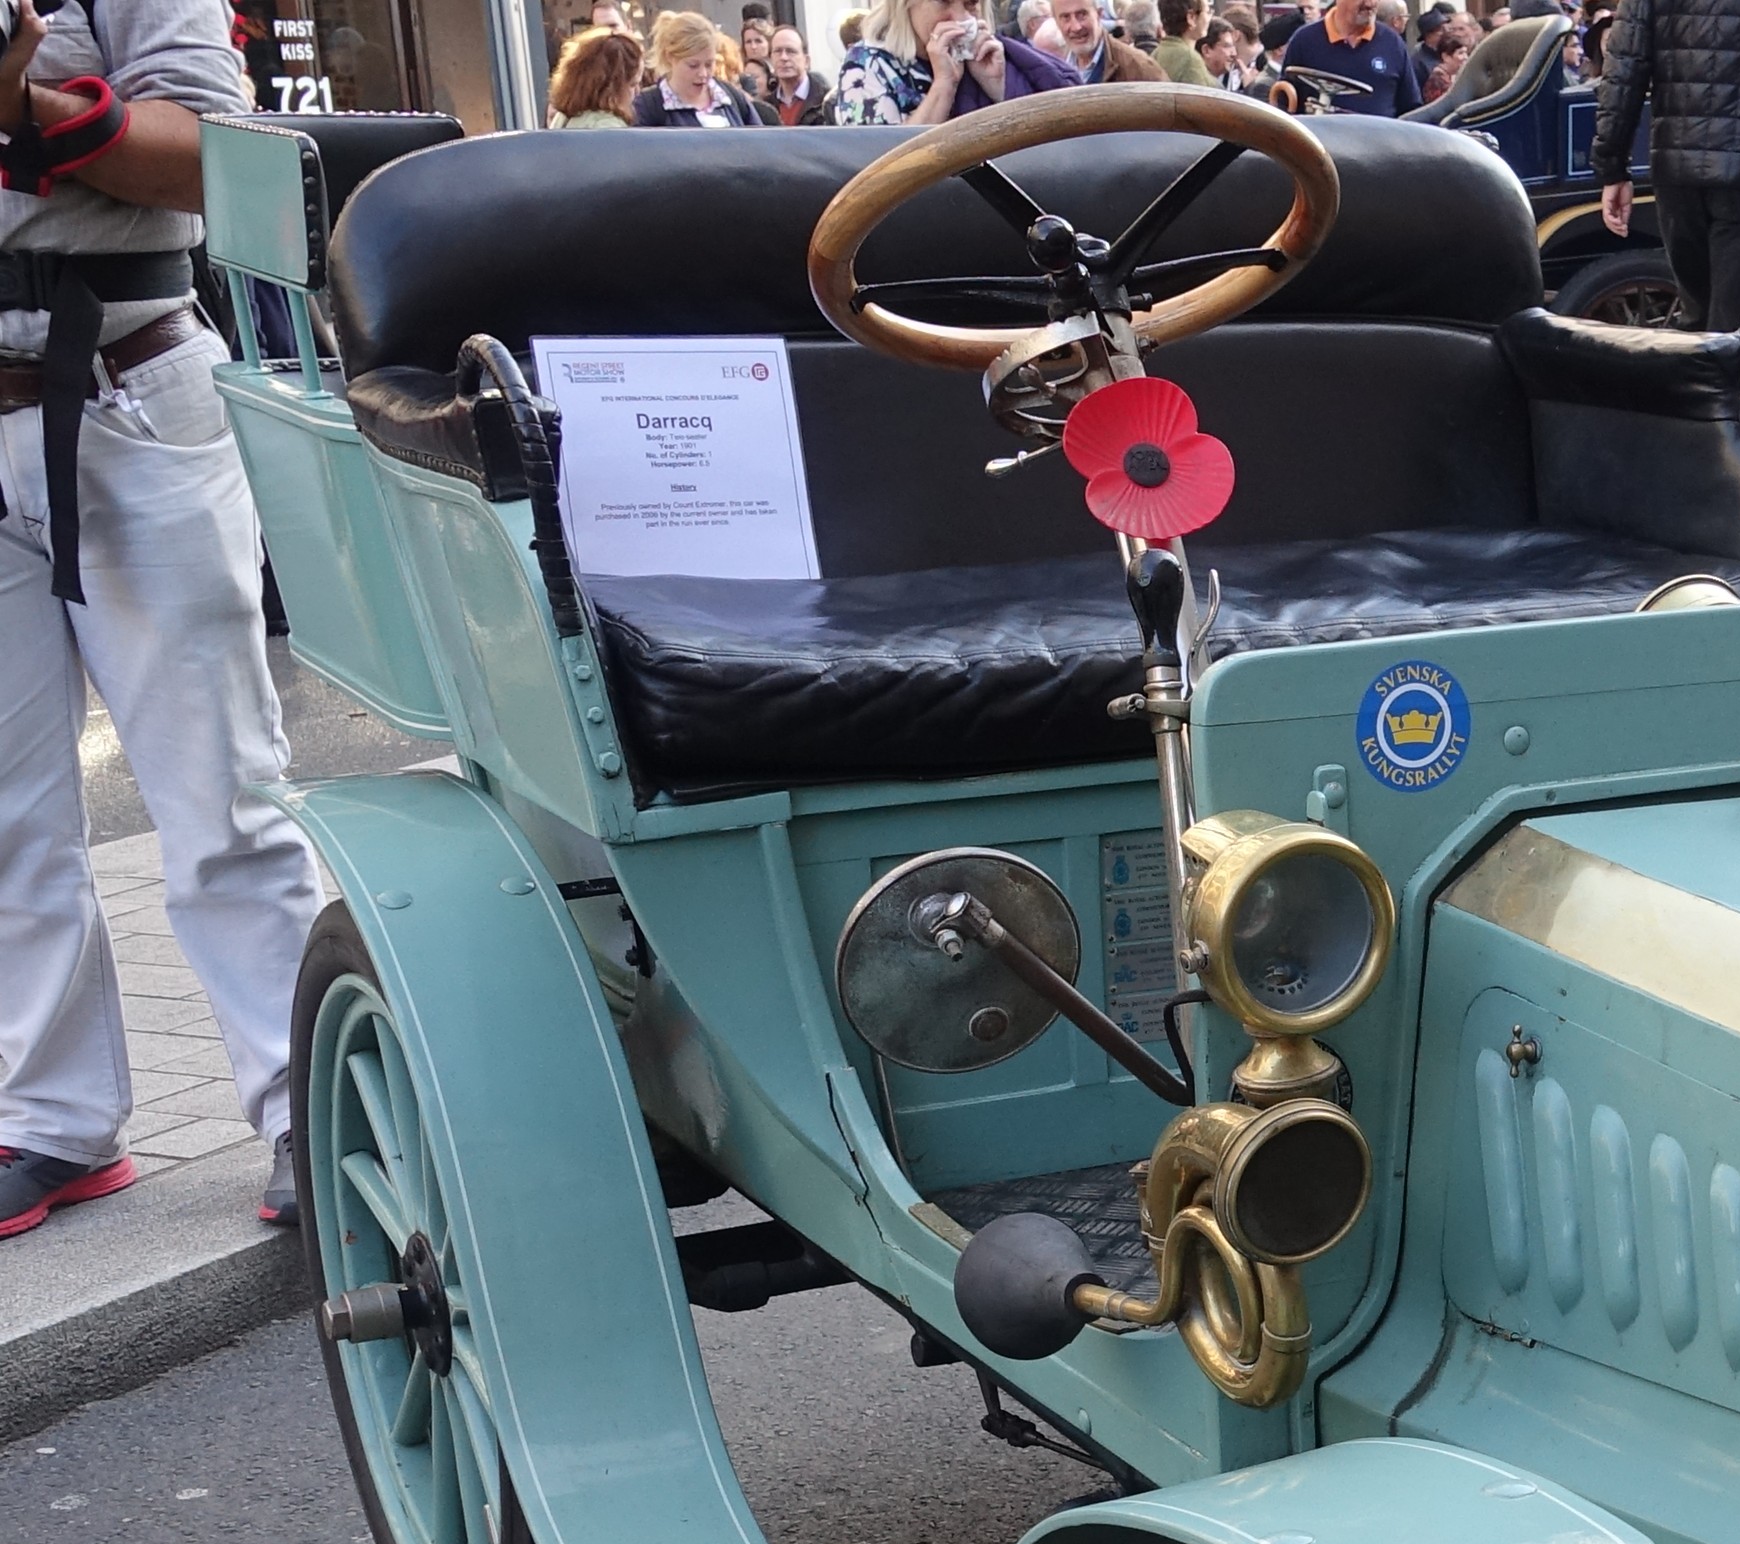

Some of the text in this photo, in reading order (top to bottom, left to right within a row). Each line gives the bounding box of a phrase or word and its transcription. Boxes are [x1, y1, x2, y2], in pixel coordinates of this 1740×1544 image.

[273, 19, 315, 38] FIRST
[280, 42, 315, 61] KISS
[271, 76, 334, 115] 721
[722, 366, 751, 379] EFG
[636, 413, 713, 432] Darracq
[1375, 665, 1452, 697] SVENSKA
[1362, 732, 1466, 787] KUNGSRALLYT
